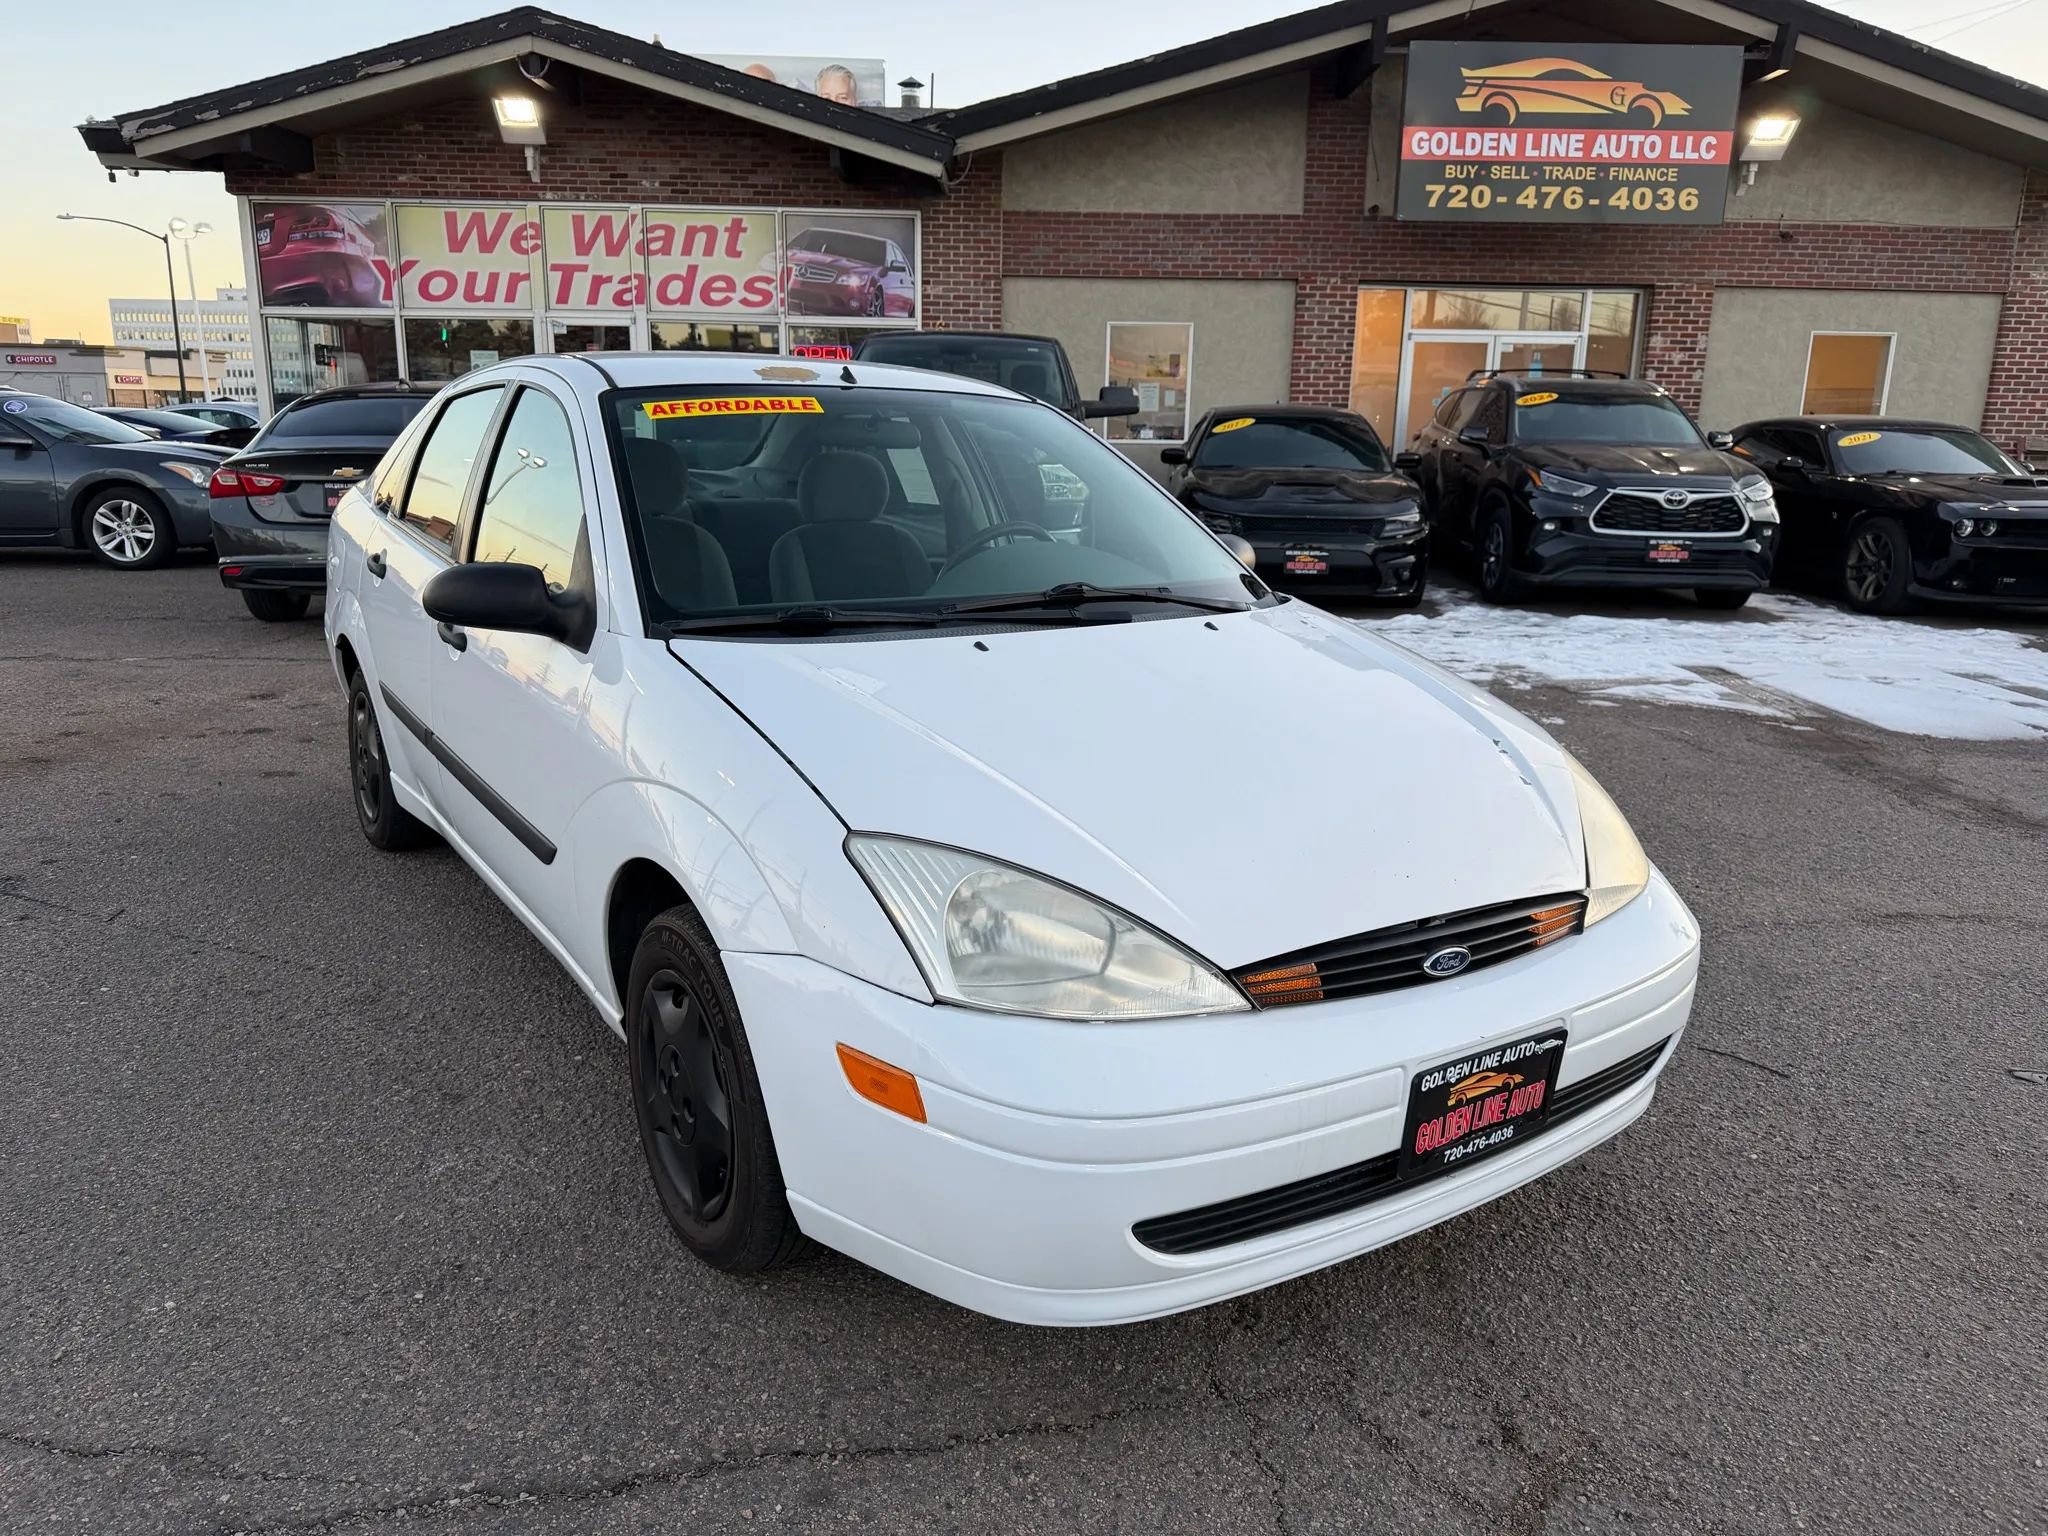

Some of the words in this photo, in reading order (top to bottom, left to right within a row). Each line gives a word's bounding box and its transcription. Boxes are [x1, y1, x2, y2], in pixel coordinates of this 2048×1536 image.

[1610, 85, 1627, 107] G
[1411, 131, 1518, 157] GOLDEN
[1525, 133, 1585, 158] LINE
[1590, 134, 1663, 159] AUTO
[1669, 135, 1718, 161] LLC
[1444, 164, 1479, 179] BUY
[1490, 165, 1531, 180] SELL
[1542, 166, 1597, 181] TRADE
[1609, 167, 1679, 182] FINANCE
[443, 210, 542, 256] We
[571, 213, 748, 259] Want
[371, 259, 530, 304] Your
[15, 355, 53, 363] CHIPOTLE
[794, 346, 850, 360] OPEN
[651, 398, 817, 417] AFFORDABLE
[1520, 393, 1554, 404] 2024
[1848, 433, 1873, 445] 2021
[1436, 953, 1461, 971] Ford
[700, 969, 725, 1029] TOUR
[1421, 1062, 1471, 1093] GOLDEN
[1472, 1050, 1503, 1075] LINE
[1501, 1040, 1536, 1065] AUTO
[1415, 1102, 1475, 1156] GOLDEN
[1471, 1092, 1509, 1131] LINE
[1505, 1079, 1547, 1121] AUTO
[1443, 1124, 1515, 1164] 720-476-4036
